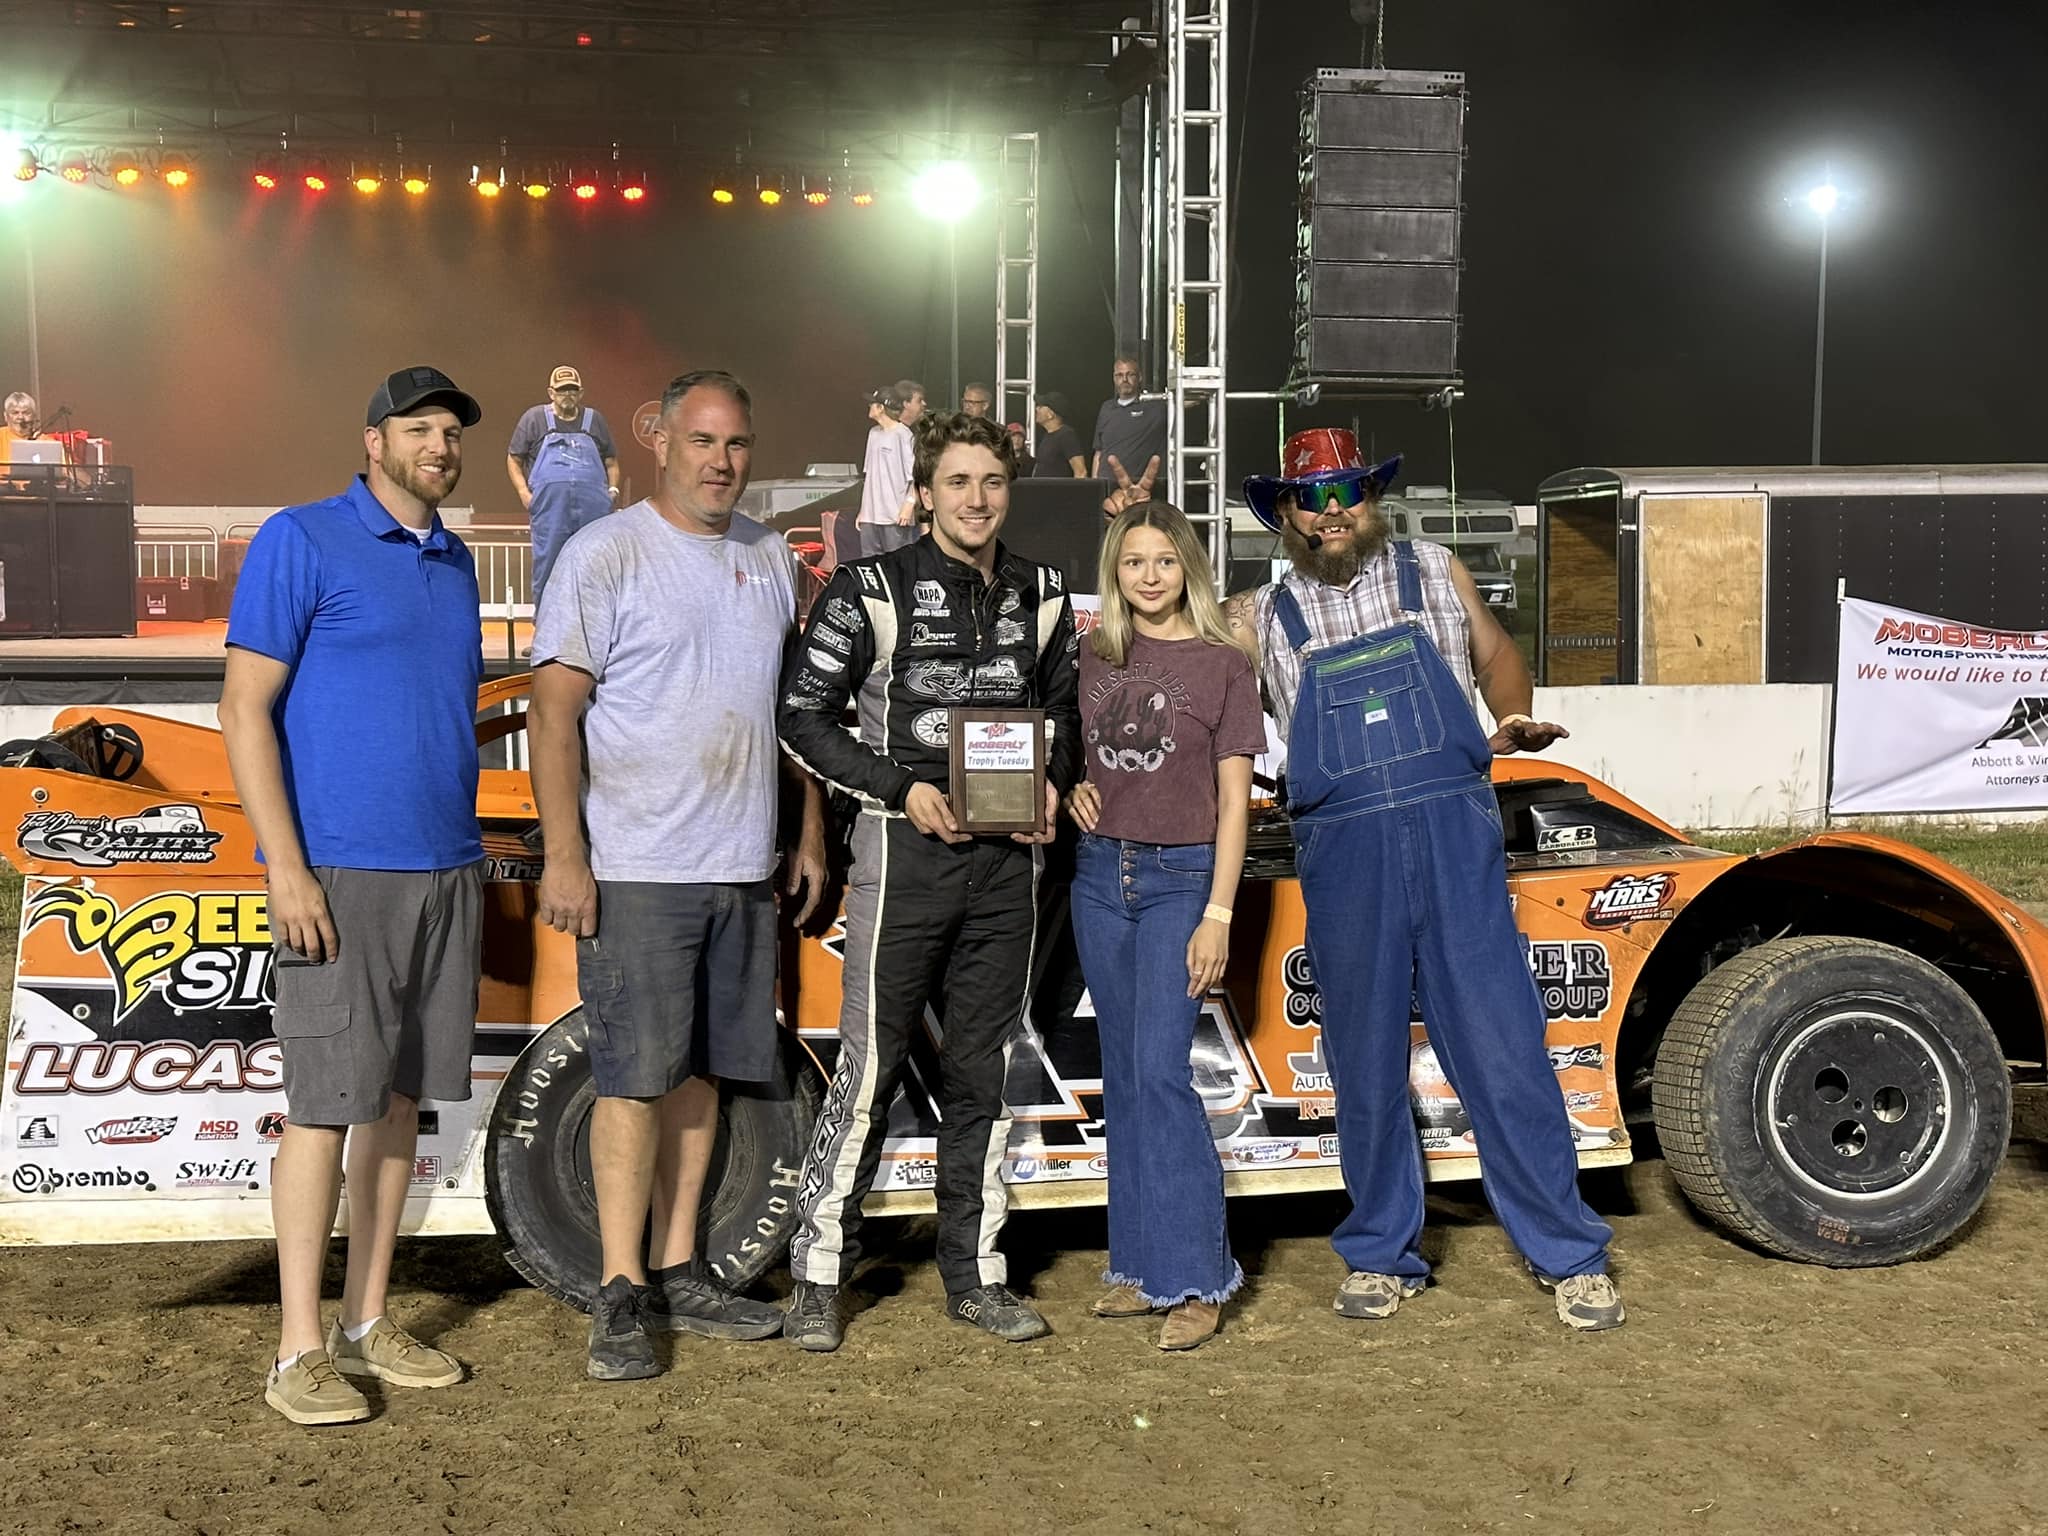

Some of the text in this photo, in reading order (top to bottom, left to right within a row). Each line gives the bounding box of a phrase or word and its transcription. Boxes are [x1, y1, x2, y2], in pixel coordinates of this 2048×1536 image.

[915, 588, 941, 602] NAPA
[1874, 617, 2048, 653] MOBERL
[1887, 646, 2004, 660] MOTORSPORTS
[1857, 663, 1887, 680] We
[1895, 667, 1960, 683] would
[1965, 667, 2005, 683] like
[2012, 669, 2032, 683] to
[968, 740, 1027, 750] MOBERLY
[968, 756, 1030, 768] Trophy Tuesday
[1972, 755, 2012, 768] Abbott
[2016, 754, 2024, 767] &
[1985, 775, 2040, 787] Attorneys
[104, 850, 213, 861] PAINT & BODY SHOP
[1590, 882, 1665, 914] MARS
[175, 950, 277, 1001] SI
[17, 1043, 286, 1094] LUCAS
[86, 1116, 178, 1144] WINTERS
[200, 1120, 239, 1133] MSD
[195, 1133, 239, 1141] IGNITION
[1232, 1142, 1299, 1153] PERFORMANCE
[1039, 1159, 1072, 1171] Miller
[49, 1167, 150, 1189] brembo
